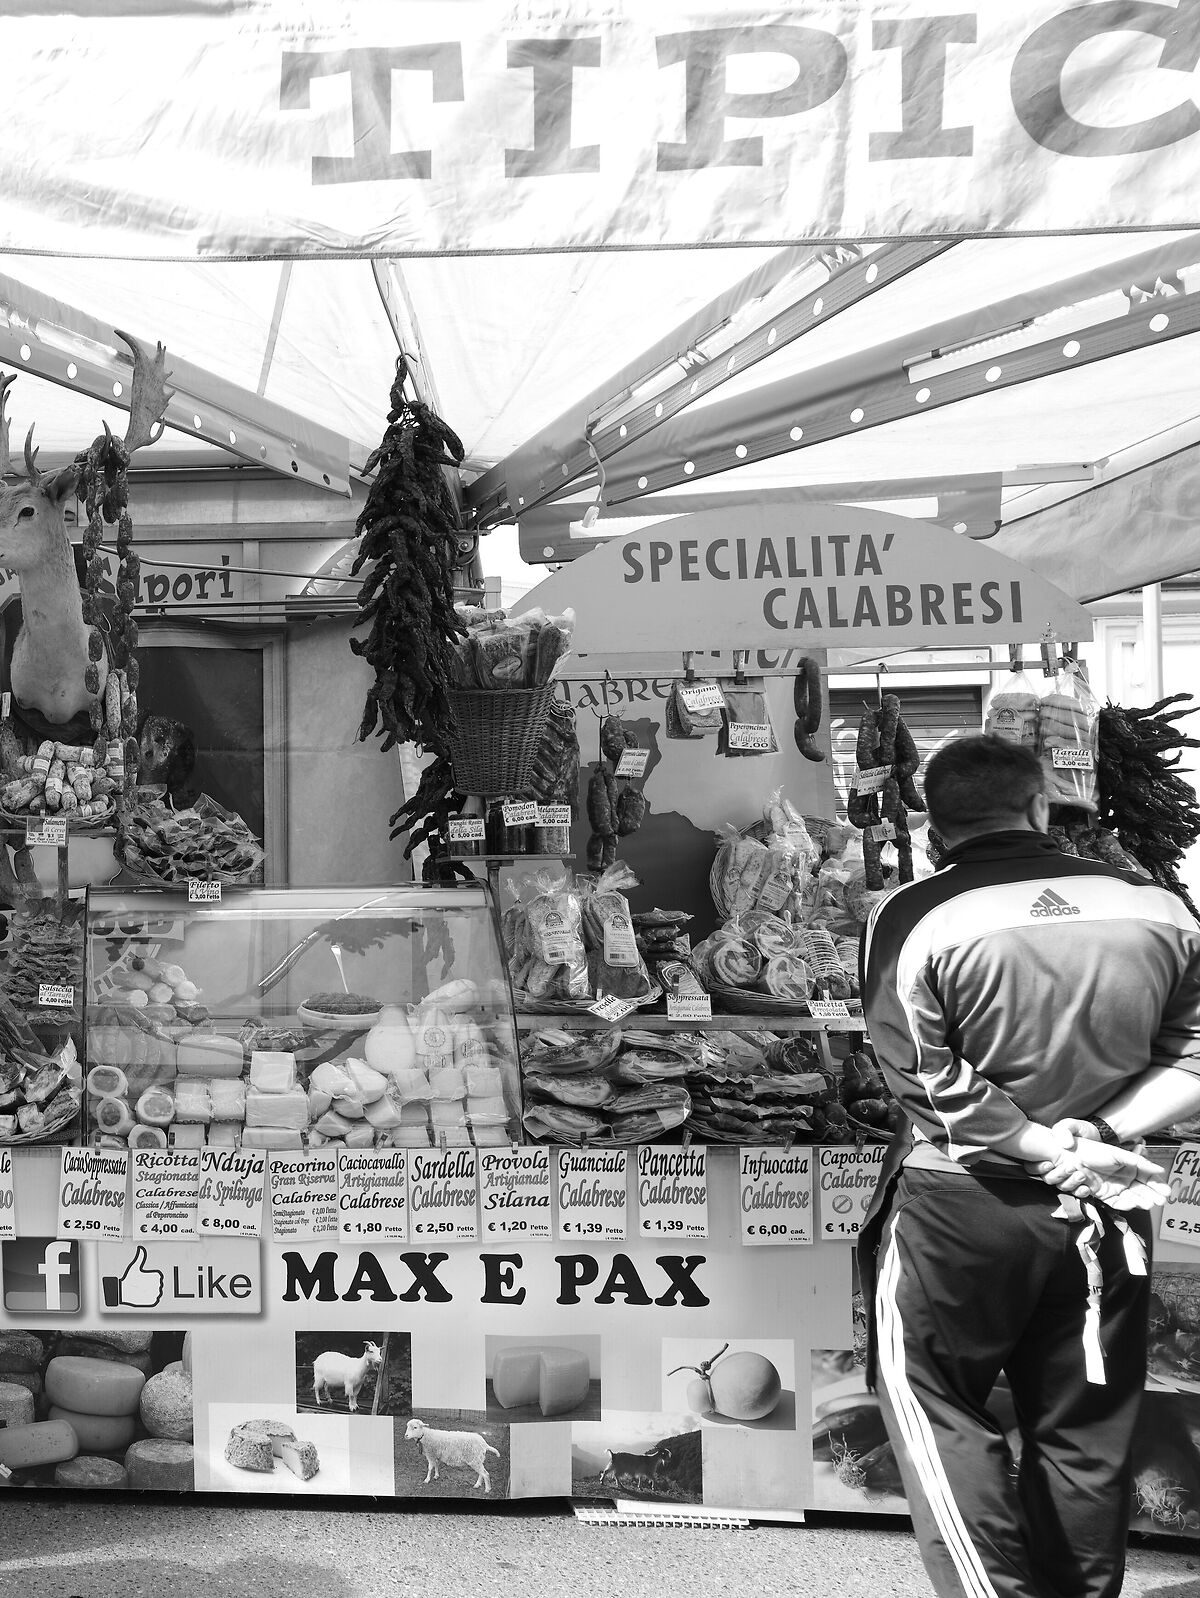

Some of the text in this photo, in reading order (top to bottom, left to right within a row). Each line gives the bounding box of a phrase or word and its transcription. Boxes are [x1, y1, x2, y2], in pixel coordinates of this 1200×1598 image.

[762, 580, 1023, 630] CALABRESI
[681, 685, 717, 696] Origano
[730, 722, 768, 731] Peperoncino
[730, 731, 768, 743] Calabrese
[1053, 748, 1089, 757] Taralli
[504, 803, 535, 812] Pomodori
[1030, 905, 1081, 918] adidas
[41, 984, 73, 993] Salsiccia
[667, 993, 709, 1003] Soppressata
[808, 1000, 843, 1008] Pancetta
[63, 1150, 128, 1181] CacioSoppressata
[135, 1152, 199, 1169] Ricotta
[269, 1157, 336, 1174] Pecorino
[339, 1152, 405, 1172] Caciocavallo
[411, 1150, 476, 1182] Sardella
[481, 1150, 549, 1171] Provola
[559, 1150, 626, 1179] Guanciale
[638, 1146, 706, 1177] Pancetta
[741, 1150, 809, 1183] Infuocata
[135, 1170, 199, 1185] Stagionata
[270, 1172, 336, 1190] Gran Riserva
[340, 1171, 405, 1192] Artigianale
[483, 1169, 549, 1191] Artigianale
[61, 1178, 126, 1209] Calabrese
[135, 1187, 199, 1199] Calabrese
[199, 1177, 264, 1209] di Spilinga
[272, 1190, 337, 1206] Calabrese
[411, 1180, 476, 1212] Calabrese
[559, 1178, 626, 1210] Calabrese
[639, 1176, 707, 1207] Calabrese
[741, 1180, 810, 1213] Calabrese
[135, 1200, 160, 1210] Classica
[339, 1191, 405, 1211] Calabrese
[483, 1190, 550, 1210] Silana
[145, 1210, 189, 1221] al Peperoncino
[63, 1219, 71, 1230] €
[74, 1219, 101, 1231] 2,50
[140, 1224, 148, 1233] €
[150, 1223, 179, 1235] 4,00
[201, 1218, 210, 1228] €
[213, 1218, 240, 1230] 8,00
[273, 1226, 298, 1236] Stagionato
[343, 1223, 351, 1233] €
[355, 1222, 383, 1234] 1,80
[415, 1223, 423, 1233] €
[427, 1222, 455, 1235] 2,50
[487, 1222, 496, 1232] €
[500, 1220, 528, 1233] 1,20
[562, 1223, 571, 1233] €
[575, 1222, 603, 1235] 1,39
[642, 1219, 651, 1230] €
[655, 1219, 684, 1232] 1,39
[747, 1225, 755, 1236] €
[758, 1224, 788, 1237] 6,00
[825, 1222, 834, 1233] €
[1165, 1218, 1176, 1229] €
[172, 1263, 253, 1301] Like
[282, 1251, 711, 1307] MAX E PAX
